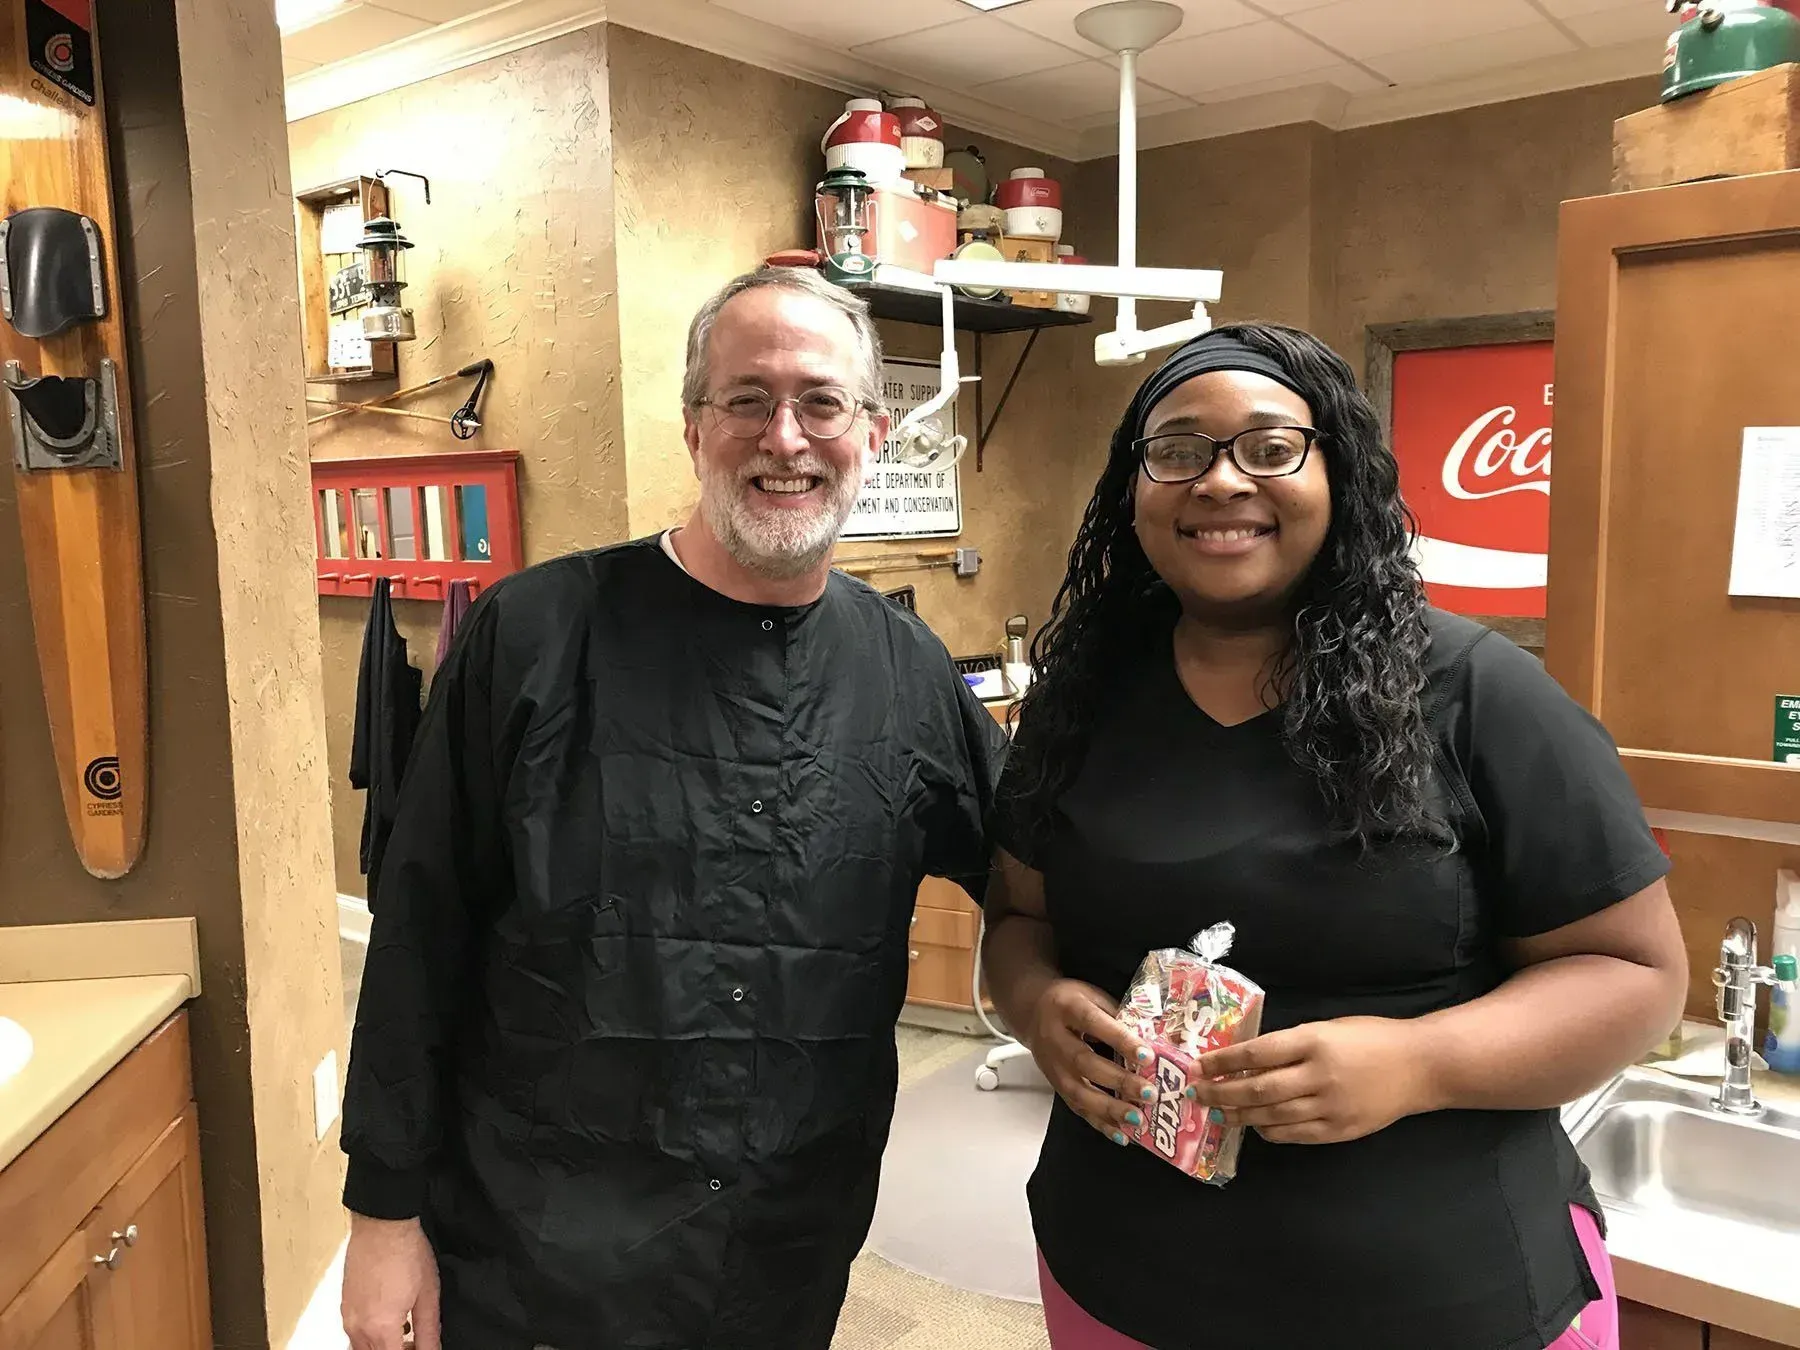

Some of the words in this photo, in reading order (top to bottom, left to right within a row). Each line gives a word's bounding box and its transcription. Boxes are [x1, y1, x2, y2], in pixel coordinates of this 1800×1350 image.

[31, 79, 88, 120] Challeer
[62, 80, 92, 102] GARDENS
[882, 382, 904, 400] ATER
[1441, 405, 1552, 500] Coc
[886, 472, 932, 489] DEPARTMENT
[936, 472, 946, 489] OF
[885, 497, 900, 514] AND
[903, 496, 954, 513] CONSERVATION
[87, 802, 123, 810] CYPRESS
[87, 809, 124, 817] GARDENS
